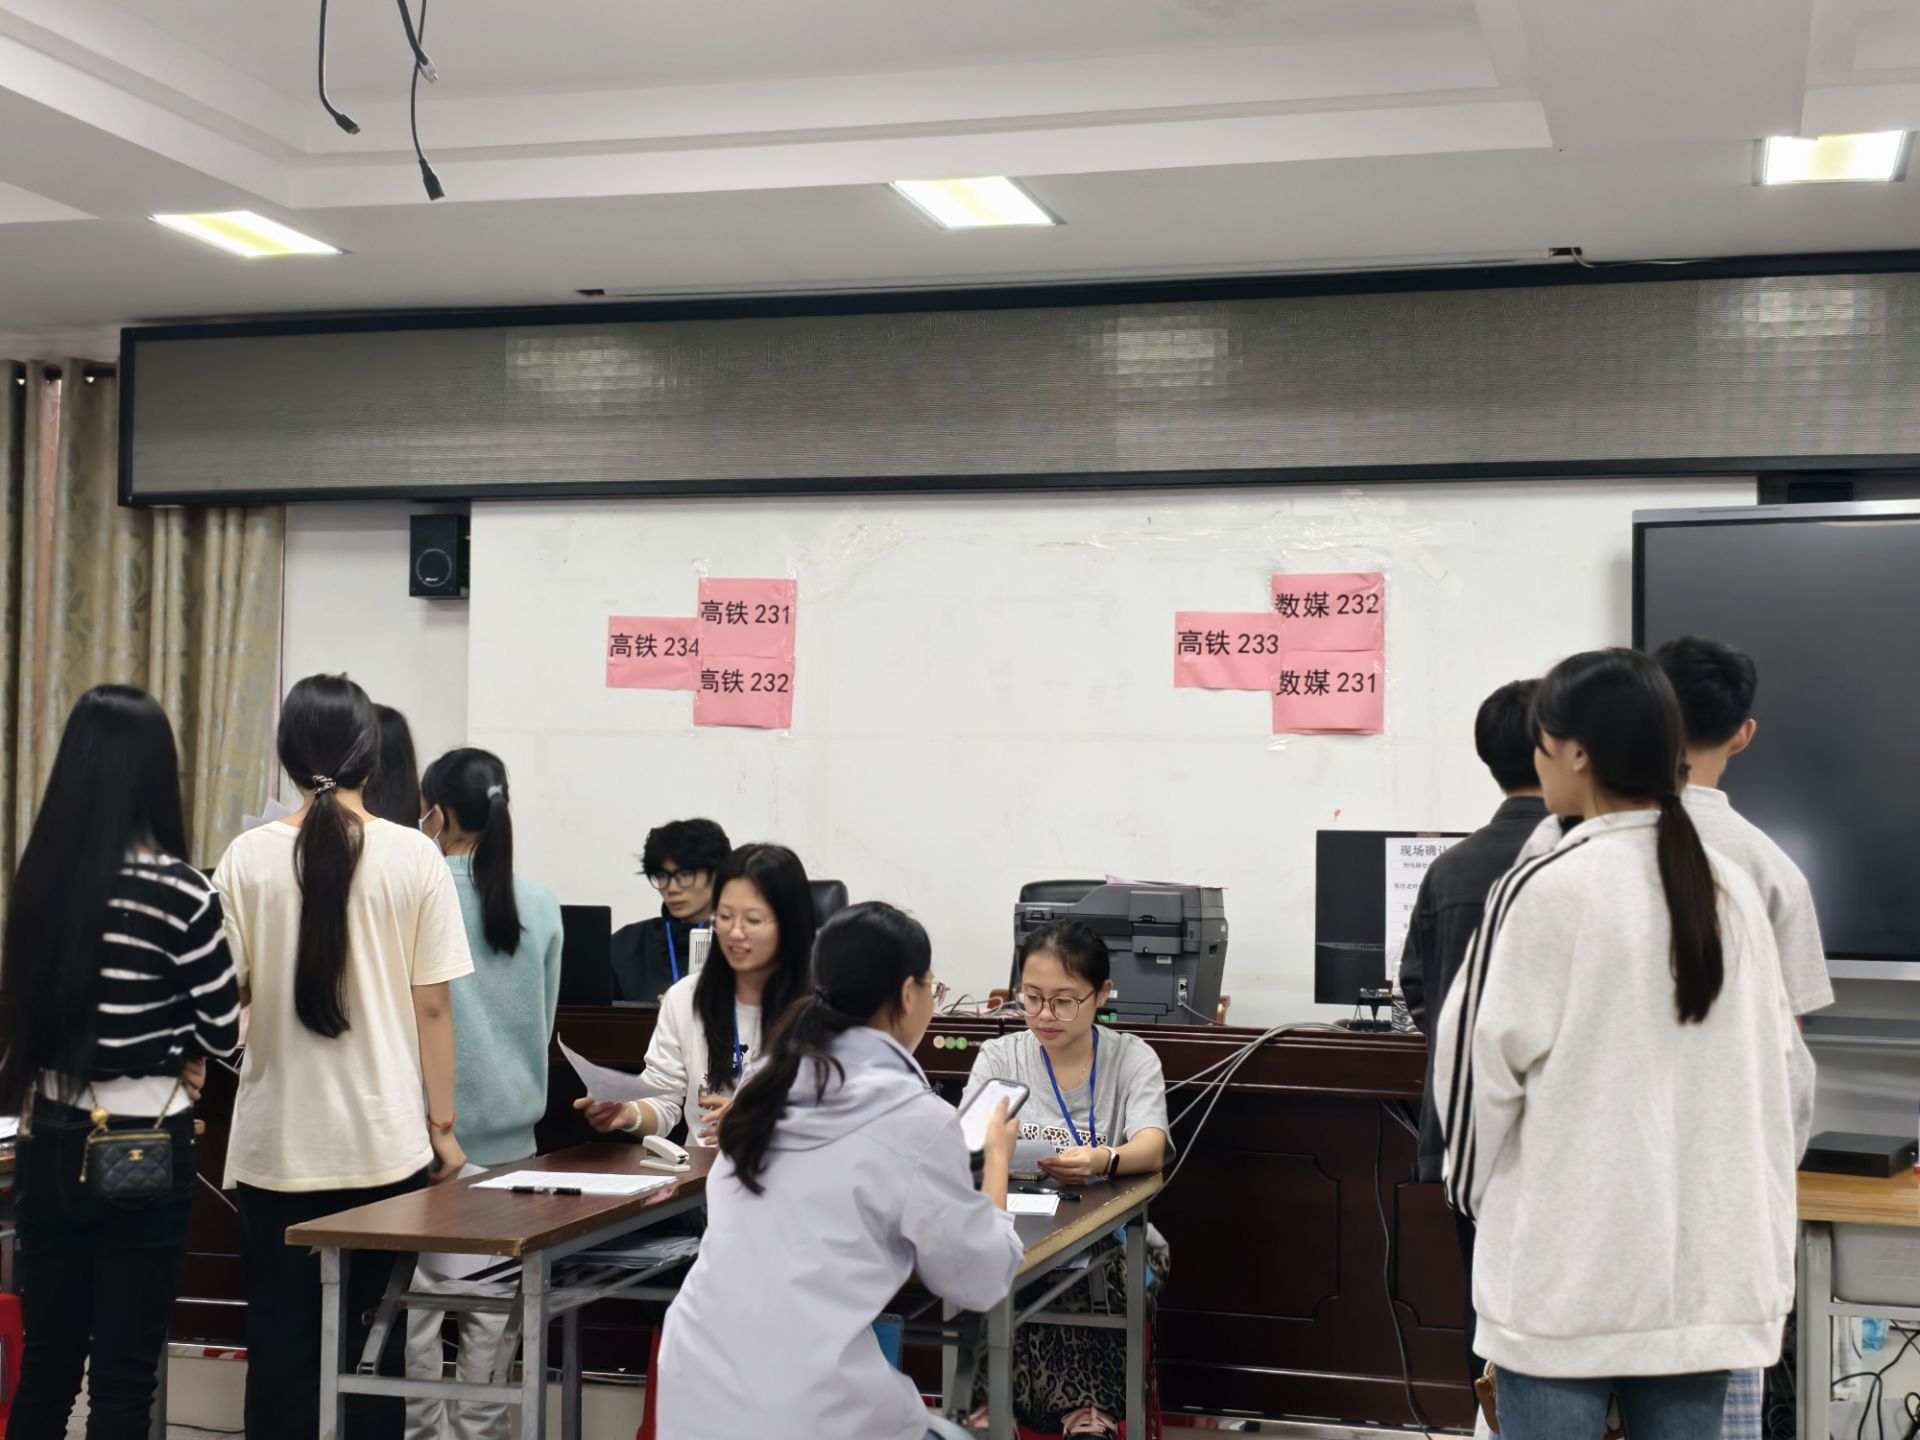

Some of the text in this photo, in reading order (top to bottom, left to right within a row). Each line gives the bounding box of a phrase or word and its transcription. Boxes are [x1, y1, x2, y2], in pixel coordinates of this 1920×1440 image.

[701, 600, 790, 625] 高铁 231
[1275, 591, 1380, 619] 数媒 232
[610, 633, 700, 658] 高铁 234
[1177, 629, 1279, 656] 高铁 233
[699, 668, 789, 694] 高铁 232
[1275, 669, 1376, 696] 数媒 231
